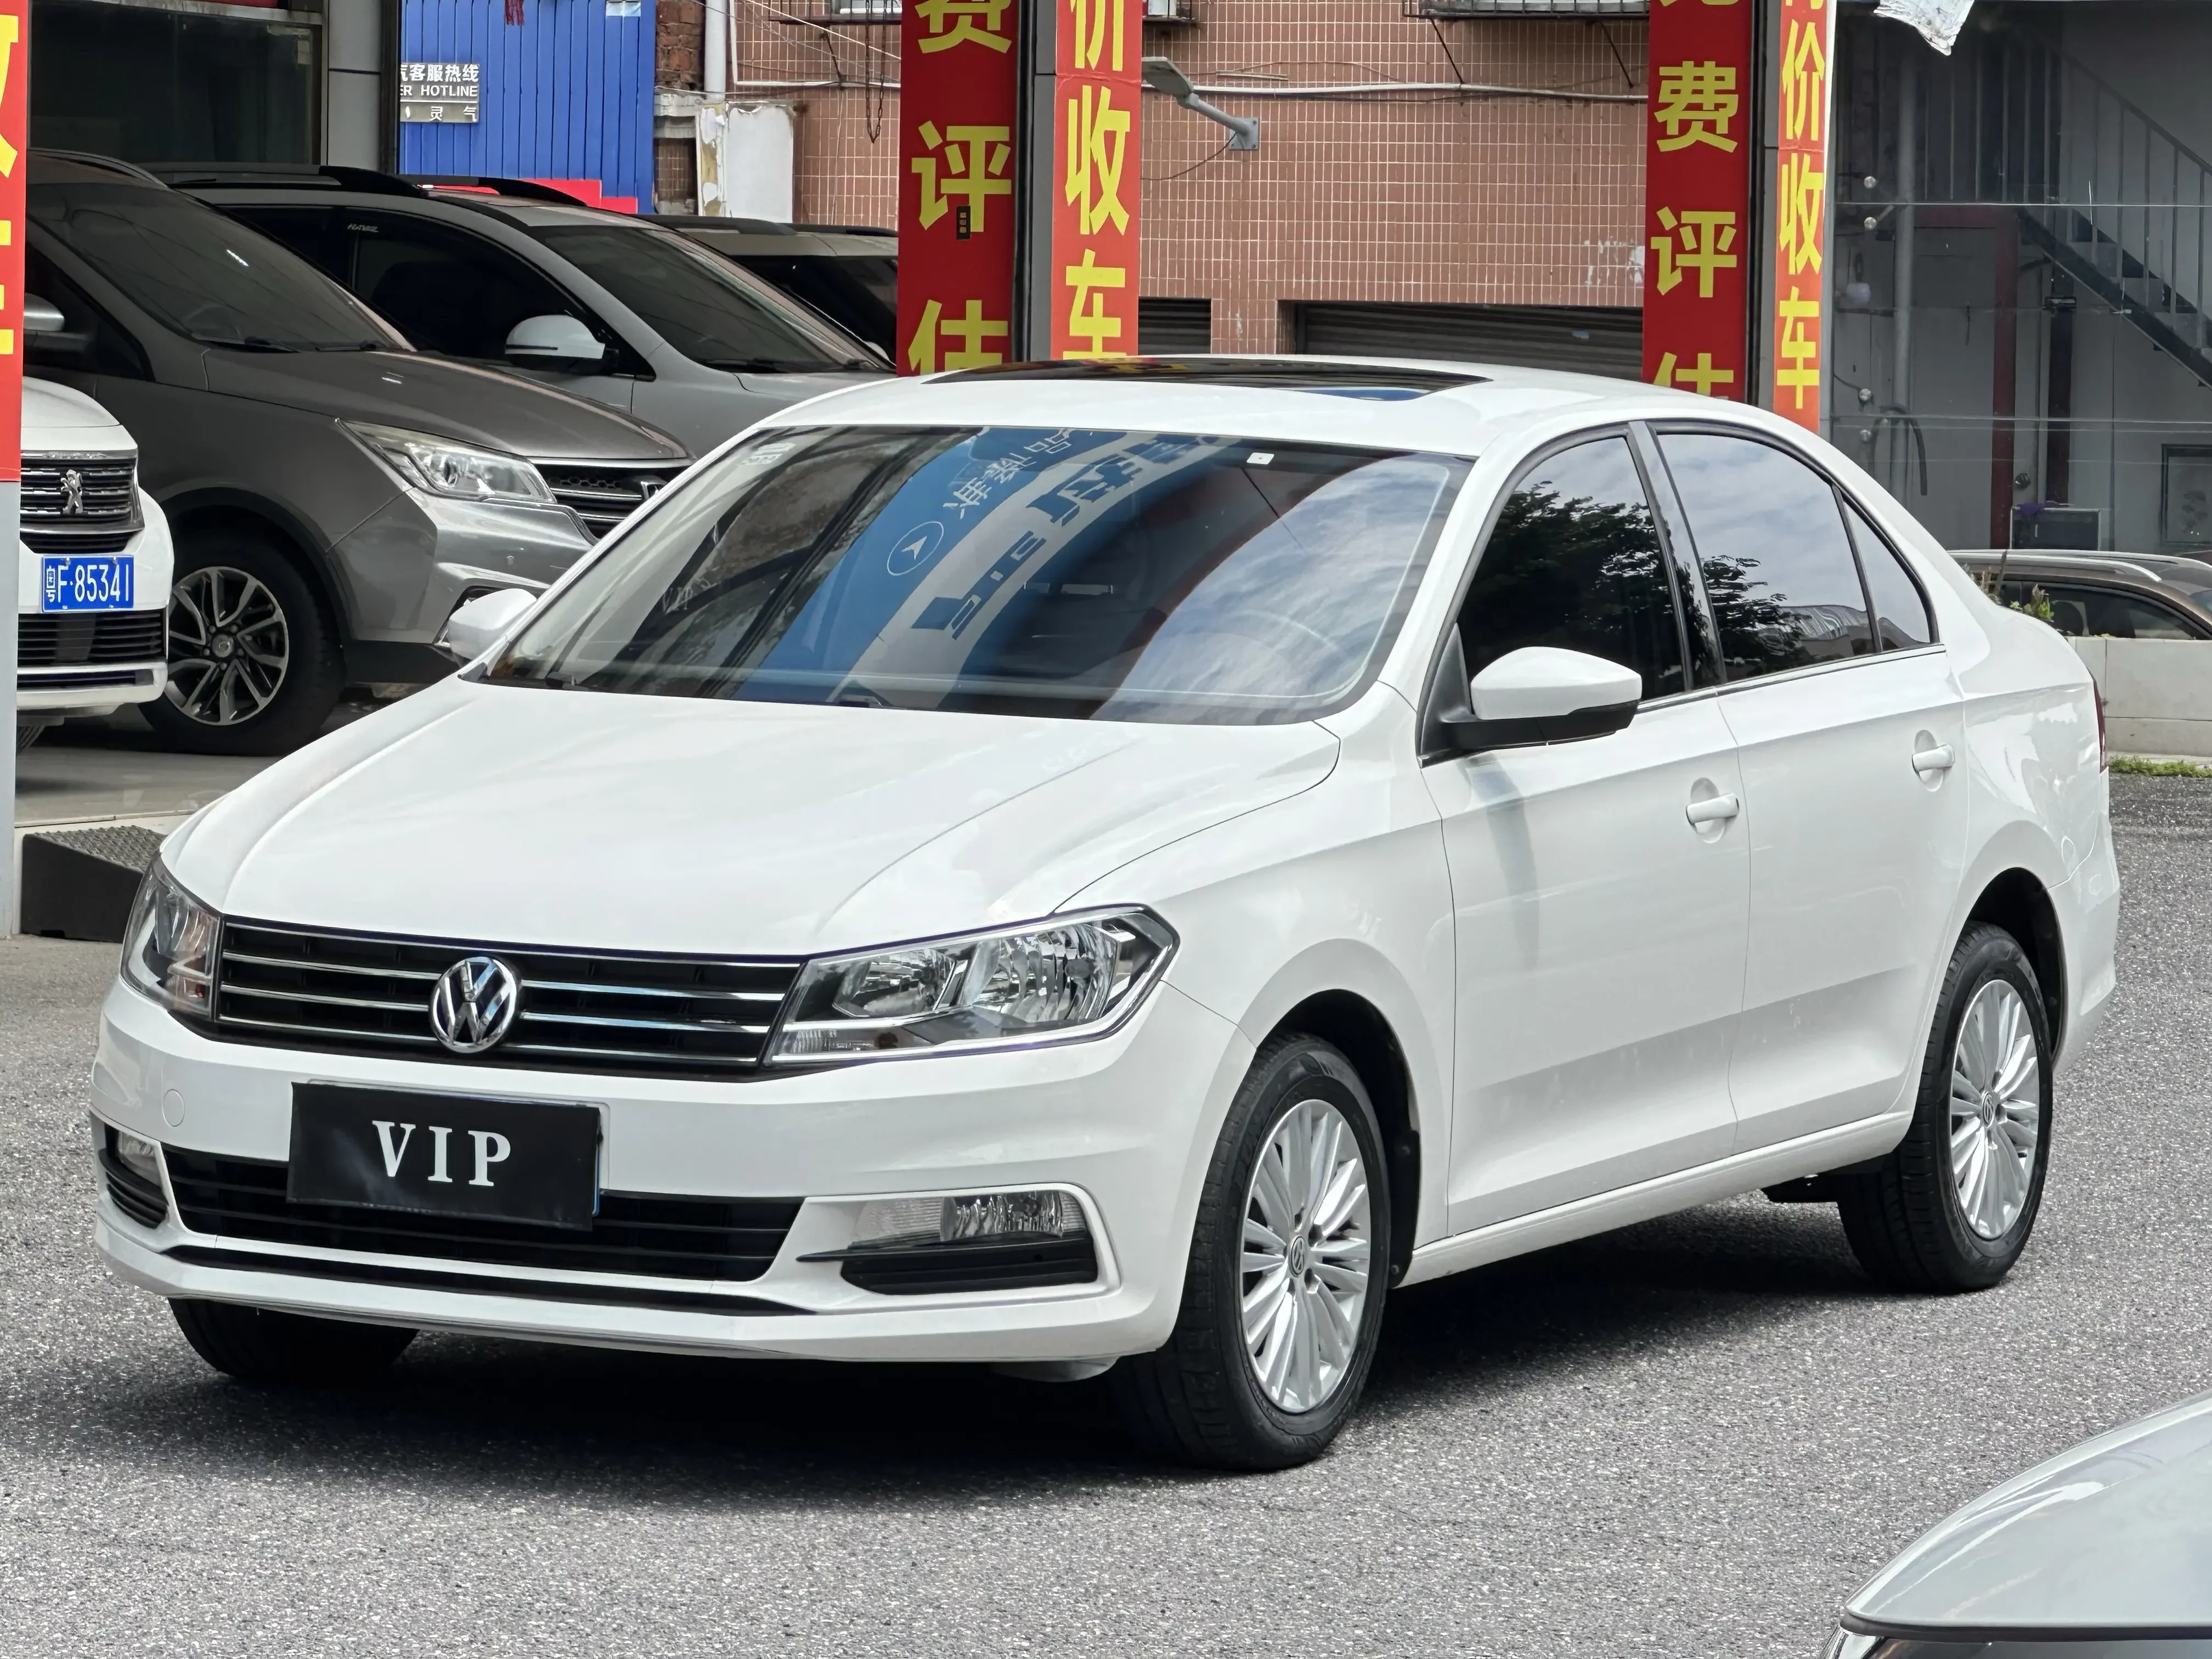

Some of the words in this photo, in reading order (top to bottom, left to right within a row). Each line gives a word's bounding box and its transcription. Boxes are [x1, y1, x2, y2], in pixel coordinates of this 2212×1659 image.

[421, 84, 478, 97] HOTLINE
[1651, 0, 1739, 399] 费评
[1776, 0, 1825, 409] 价收车
[372, 1120, 511, 1187] VIP
